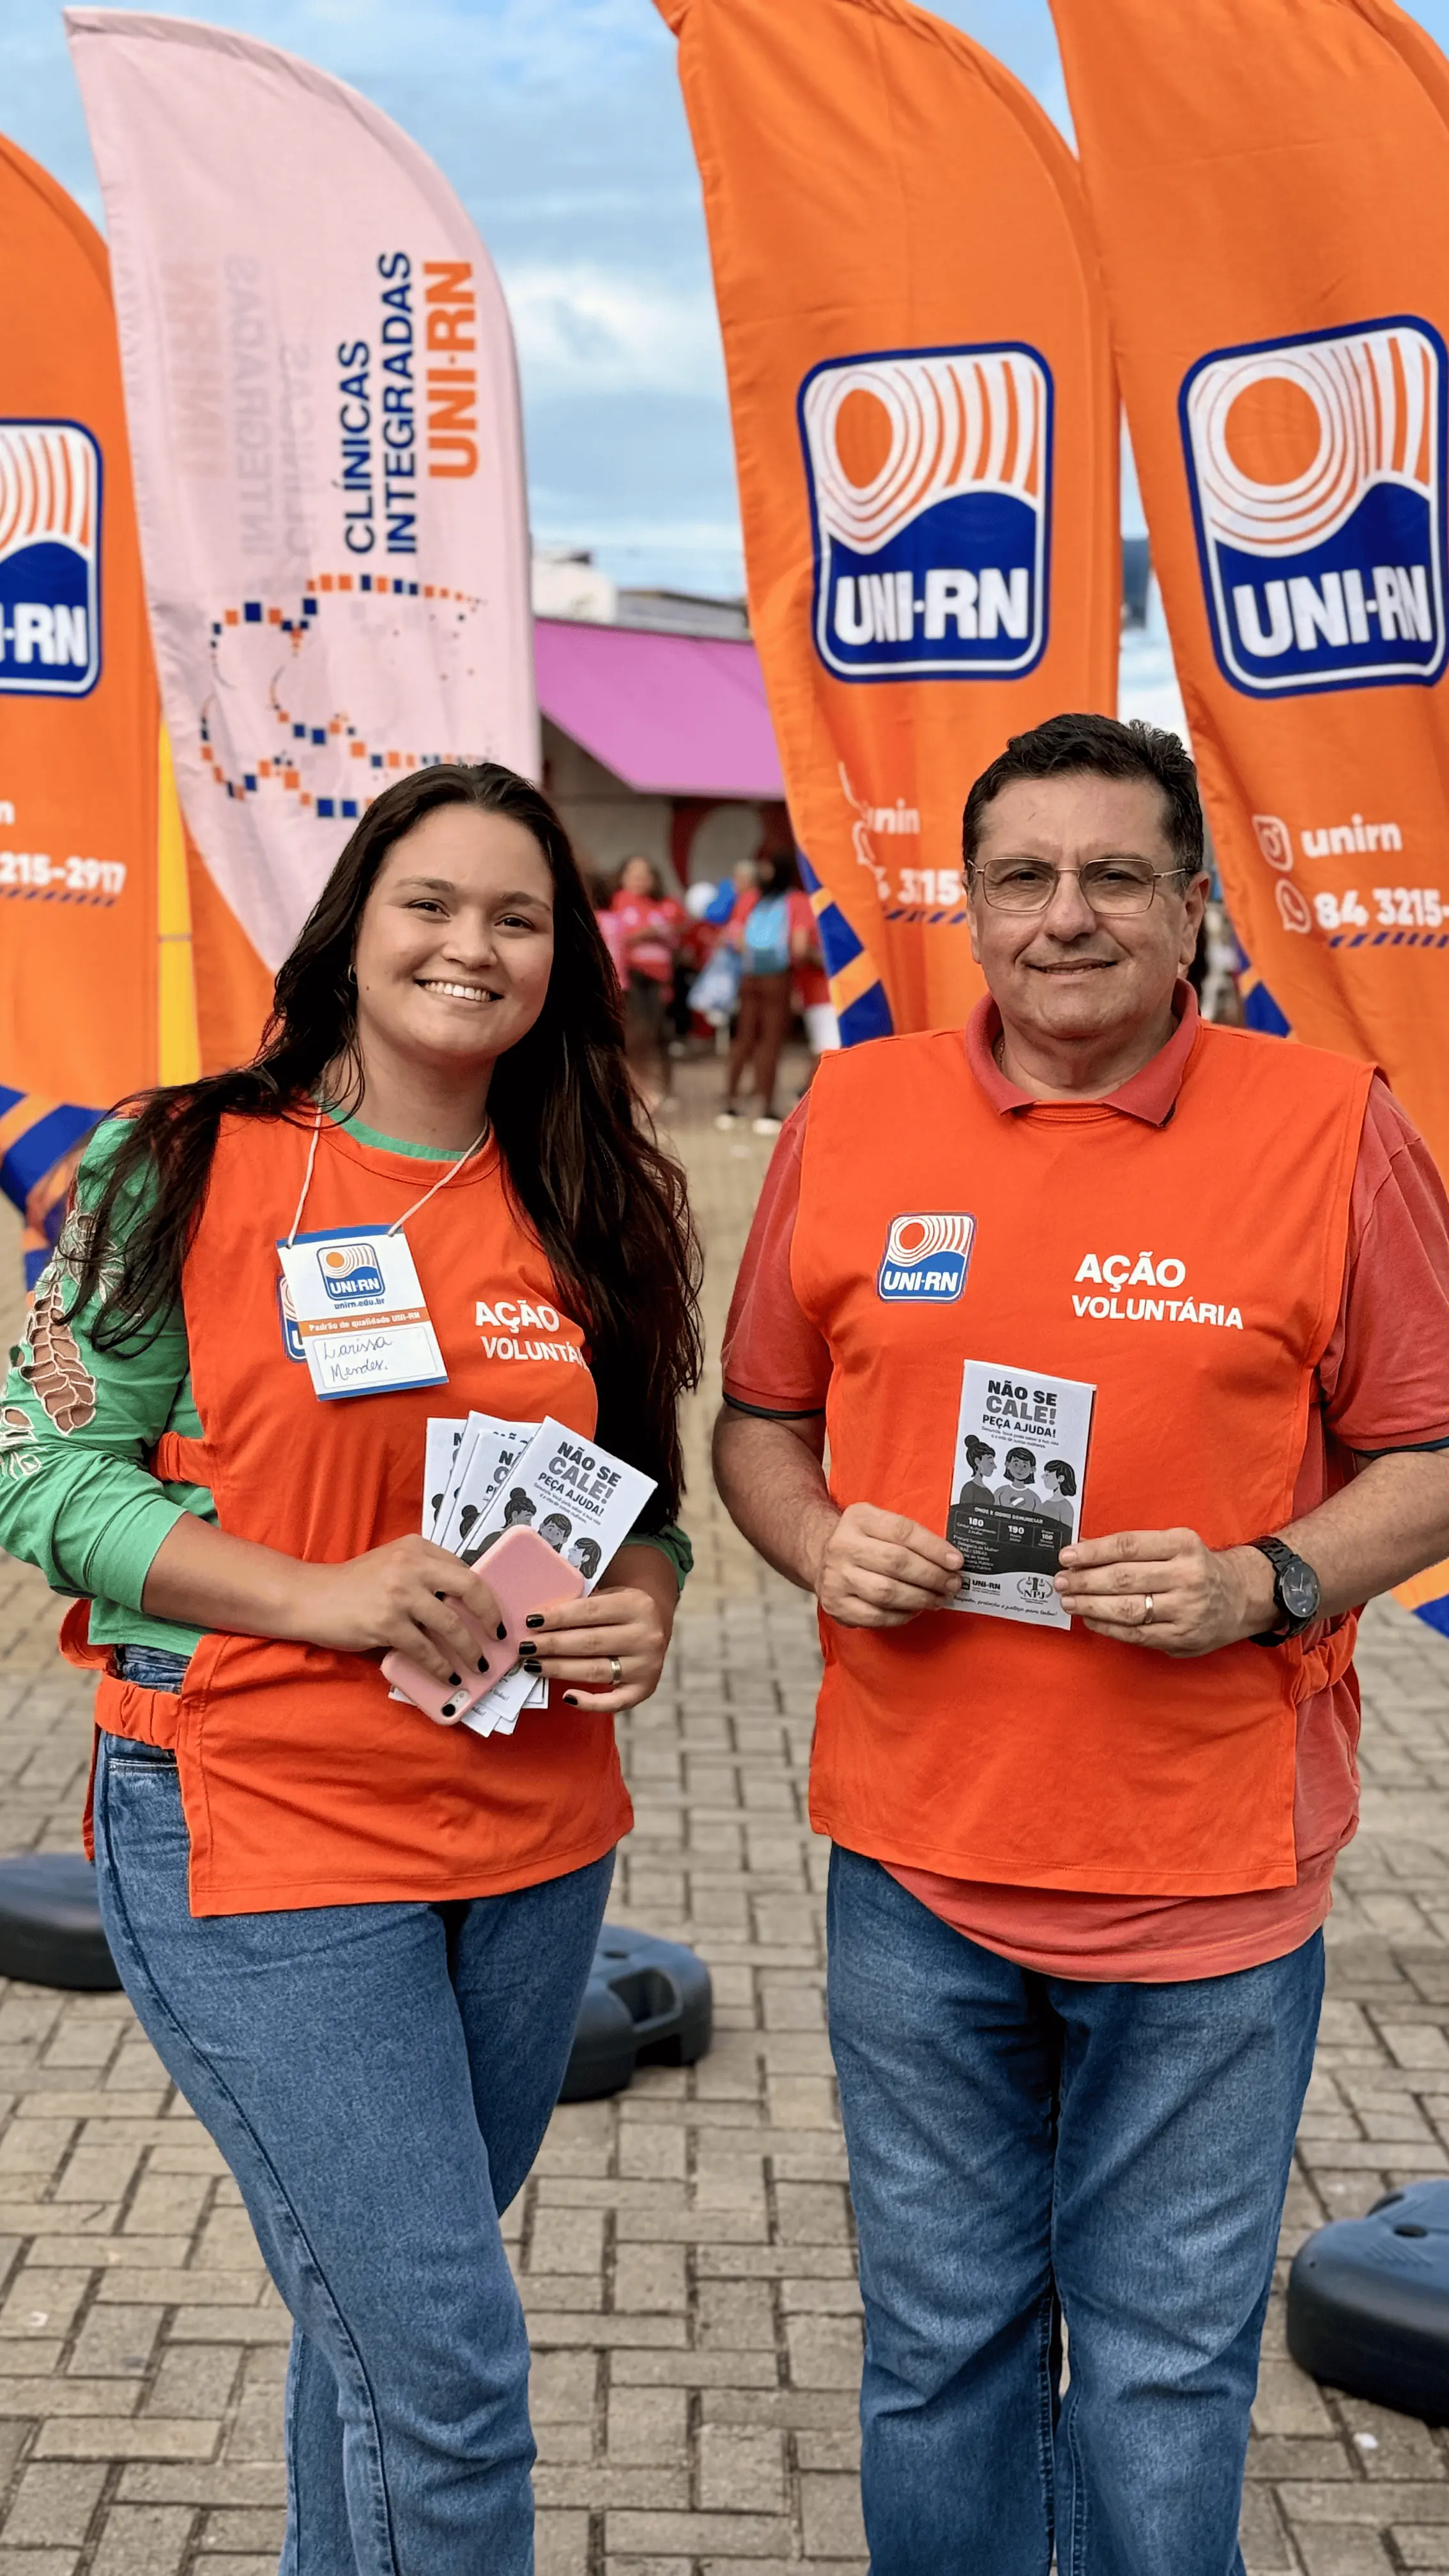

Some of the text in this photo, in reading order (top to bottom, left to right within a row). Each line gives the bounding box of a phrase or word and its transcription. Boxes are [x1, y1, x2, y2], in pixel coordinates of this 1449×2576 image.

[377, 251, 418, 554] INTEGRADAS
[332, 340, 375, 554] CLÍNICAS
[834, 567, 1029, 646] UNI-RN
[1232, 564, 1433, 658] UNI-RN
[1301, 813, 1403, 858] unirn
[1314, 890, 1370, 930] 84
[330, 1278, 380, 1294] UNI-RN
[884, 1271, 958, 1292] UNI-RN
[1074, 1251, 1186, 1293] AÇÃO
[334, 1298, 385, 1310] unirn.edu.br
[475, 1300, 560, 1334] AÇÃO
[1071, 1294, 1244, 1330] VOLUNTÁRIA
[309, 1321, 338, 1332] Padrão
[339, 1320, 350, 1329] de
[351, 1315, 391, 1329] qualidade
[324, 1337, 392, 1360] Larissa
[986, 1395, 1057, 1425] CALE!
[988, 1380, 1058, 1407] NÃO SE
[982, 1414, 1011, 1429] PEÇA
[1014, 1422, 1056, 1438] AJUDA!
[548, 1457, 614, 1504] CALE!
[557, 1441, 622, 1487] NÃO SE
[538, 1472, 564, 1494] PEÇA
[565, 1489, 604, 1517] AJUDA!
[969, 1517, 984, 1527] 180
[1008, 1525, 1025, 1535] 190
[1023, 1590, 1046, 1599] NPJ
